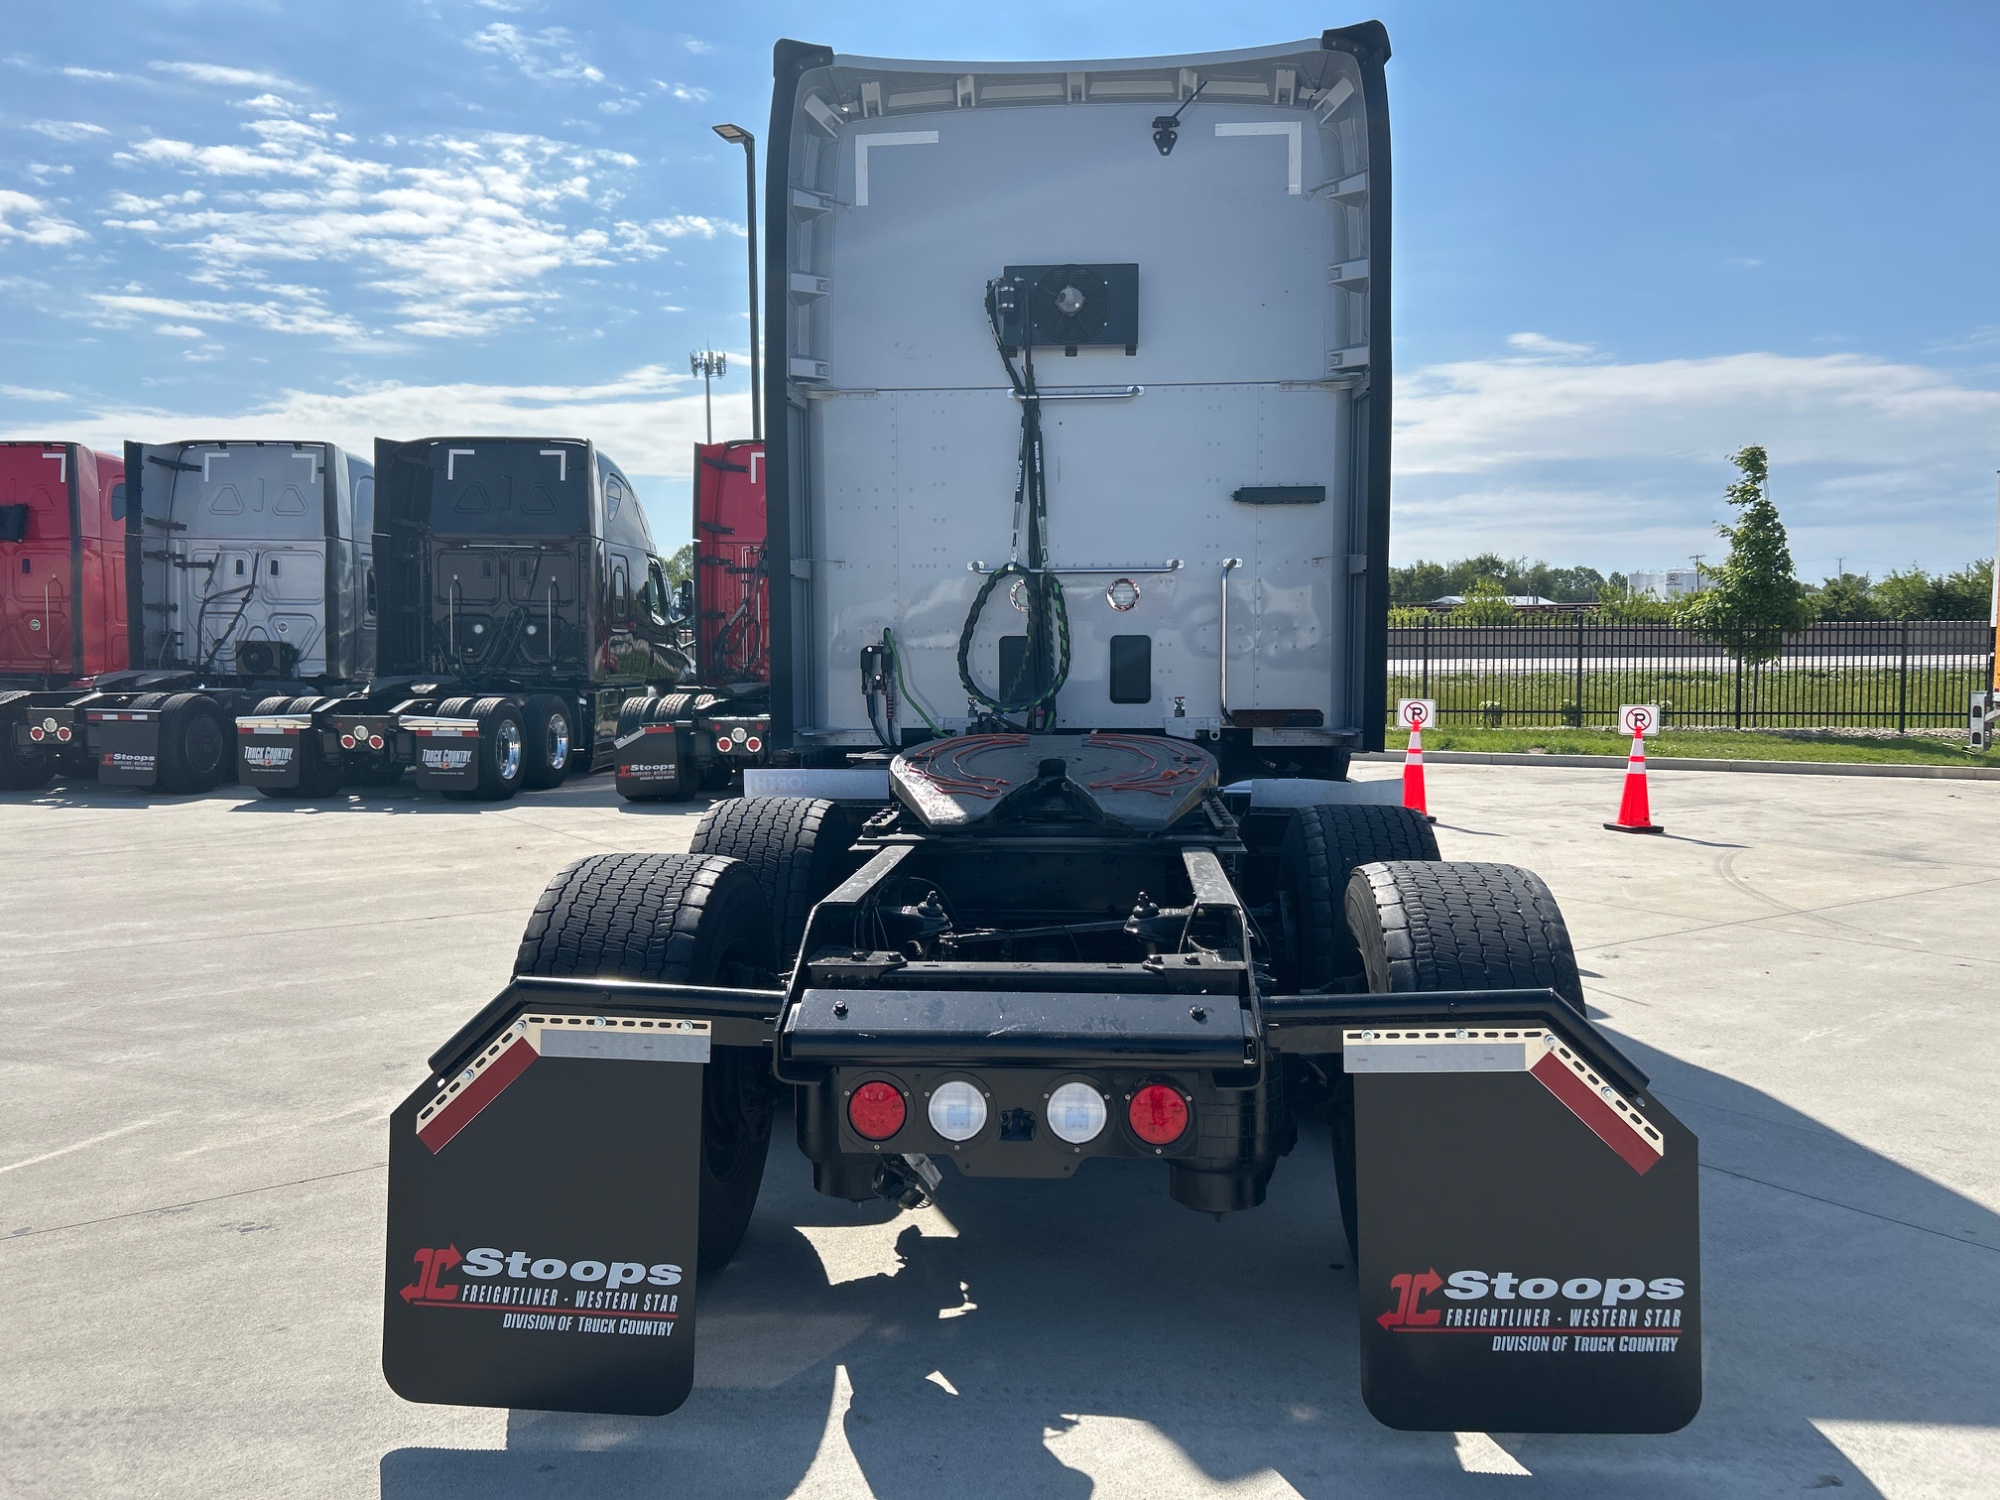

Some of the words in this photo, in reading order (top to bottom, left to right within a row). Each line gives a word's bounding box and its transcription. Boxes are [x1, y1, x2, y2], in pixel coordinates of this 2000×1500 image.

[113, 753, 155, 761] Stoops
[244, 746, 264, 759] TRUCK
[264, 746, 294, 760] COUNTRY
[422, 749, 442, 761] TRUCK
[442, 749, 472, 763] COUNTRY
[462, 1247, 683, 1289] Stoops
[1443, 1270, 1685, 1306] Stoops
[461, 1284, 558, 1307] FREIGHTLINER
[575, 1290, 638, 1311] WESTERN
[643, 1295, 679, 1313] STAR
[502, 1313, 556, 1331] DIVISION
[557, 1316, 574, 1331] OF
[577, 1316, 617, 1334] TRUCK
[618, 1318, 674, 1337] COUNTRY
[1445, 1308, 1550, 1327] FREIGHTLINER
[1569, 1309, 1638, 1327] WESTERN
[1644, 1309, 1682, 1328] STAR
[1492, 1335, 1550, 1352] DIVISION
[1551, 1335, 1568, 1352] OF
[1573, 1335, 1616, 1352] TRUCK
[1618, 1335, 1679, 1352] COUNTRY
